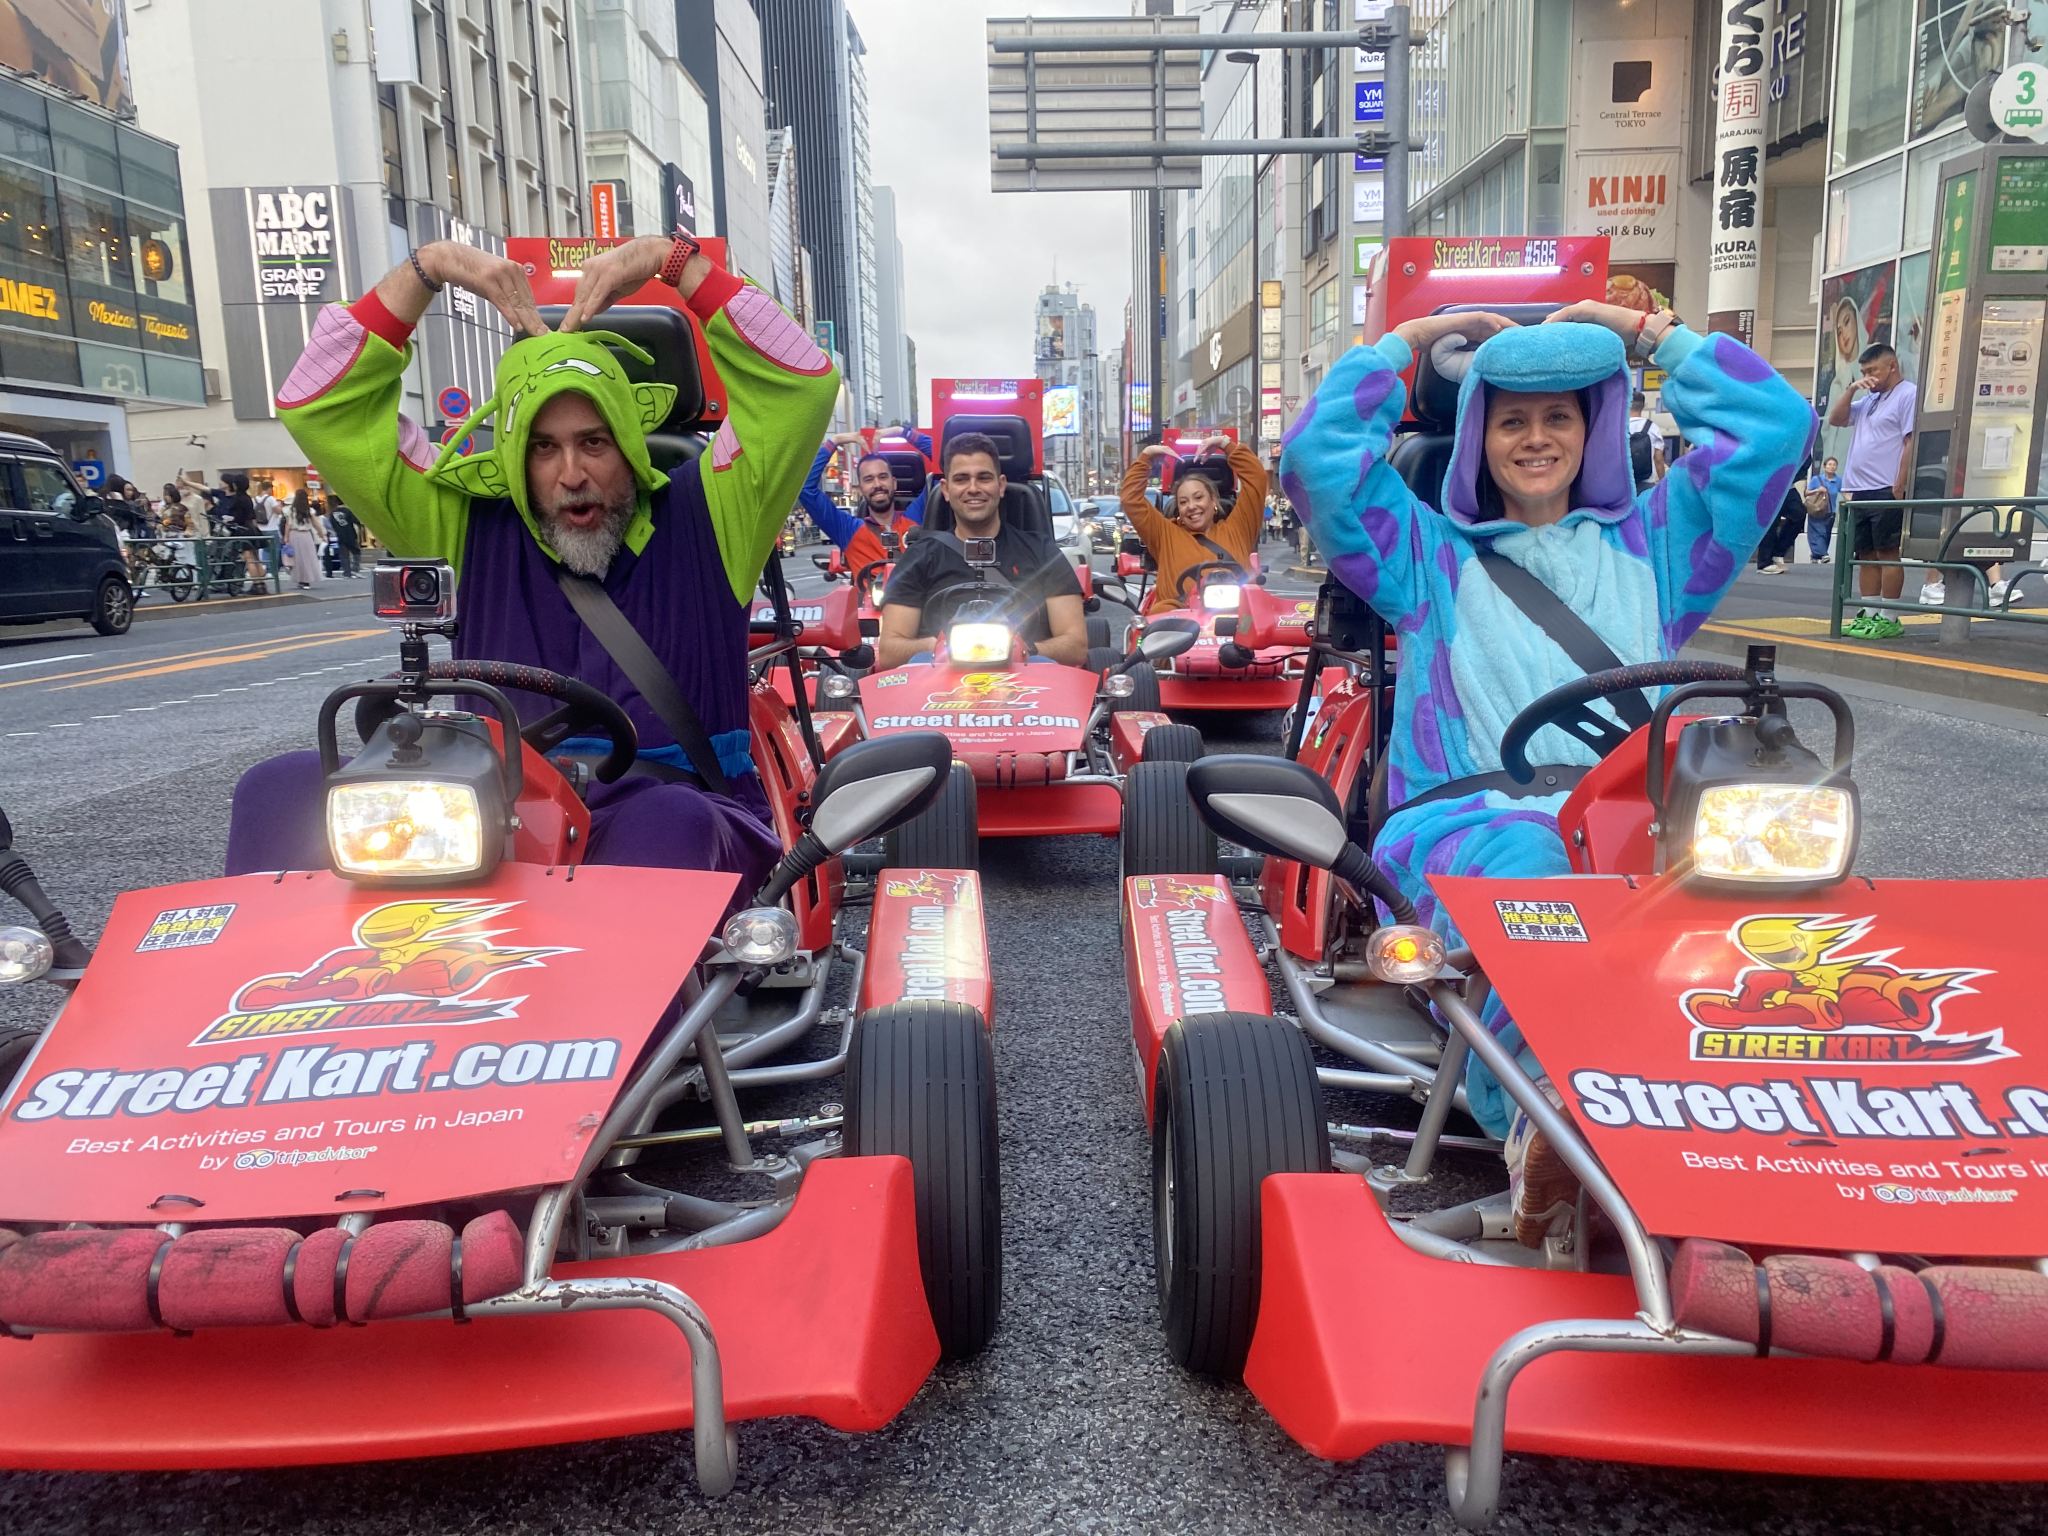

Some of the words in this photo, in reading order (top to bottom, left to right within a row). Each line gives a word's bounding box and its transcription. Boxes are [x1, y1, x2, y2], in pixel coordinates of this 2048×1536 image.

[1364, 88, 1382, 100] YM
[2015, 71, 2036, 105] 3
[1359, 100, 1384, 109] SQUAR
[1726, 83, 1758, 117] 寿司
[1600, 111, 1630, 119] Central
[1632, 110, 1661, 118] Terrace
[1615, 120, 1646, 128] TOKYO
[1720, 129, 1763, 140] HARAJUKU
[1588, 174, 1666, 208] KINJI
[1719, 146, 1759, 231] 原宿
[256, 192, 328, 229] ABC
[1621, 207, 1656, 216] clothing
[1596, 226, 1618, 237] Sell
[1621, 227, 1630, 236] &
[1633, 226, 1656, 237] Buy
[256, 231, 331, 255] MART
[1714, 240, 1756, 254] KURA
[1434, 239, 1521, 268] StreetKart.com
[1524, 240, 1558, 266] #585
[1714, 253, 1757, 263] REVOLVING
[1713, 262, 1738, 271] SUSHI
[1739, 260, 1756, 269] BAR
[261, 268, 325, 281] GRAND
[262, 282, 321, 296] STAGE
[0, 277, 59, 320] OMEZ
[89, 301, 138, 329] Mexican
[158, 905, 232, 922] 対人対物
[1498, 901, 1573, 913] 対人対物
[142, 928, 218, 946] 任意保険
[1507, 923, 1583, 937] 任意保険
[1702, 1033, 1913, 1061] STREETKART
[66, 1138, 134, 1153] Best
[138, 1127, 265, 1152] Activities
[273, 1121, 324, 1141] and
[333, 1117, 406, 1137] Tours
[414, 1113, 437, 1131] in
[444, 1106, 525, 1128] Japan
[199, 1154, 229, 1171] by
[1681, 1151, 1749, 1171] Best
[1756, 1154, 1883, 1177] Activities
[1889, 1161, 1942, 1178] and
[1941, 1161, 2029, 1178] Tours
[1836, 1183, 1865, 1200] by
